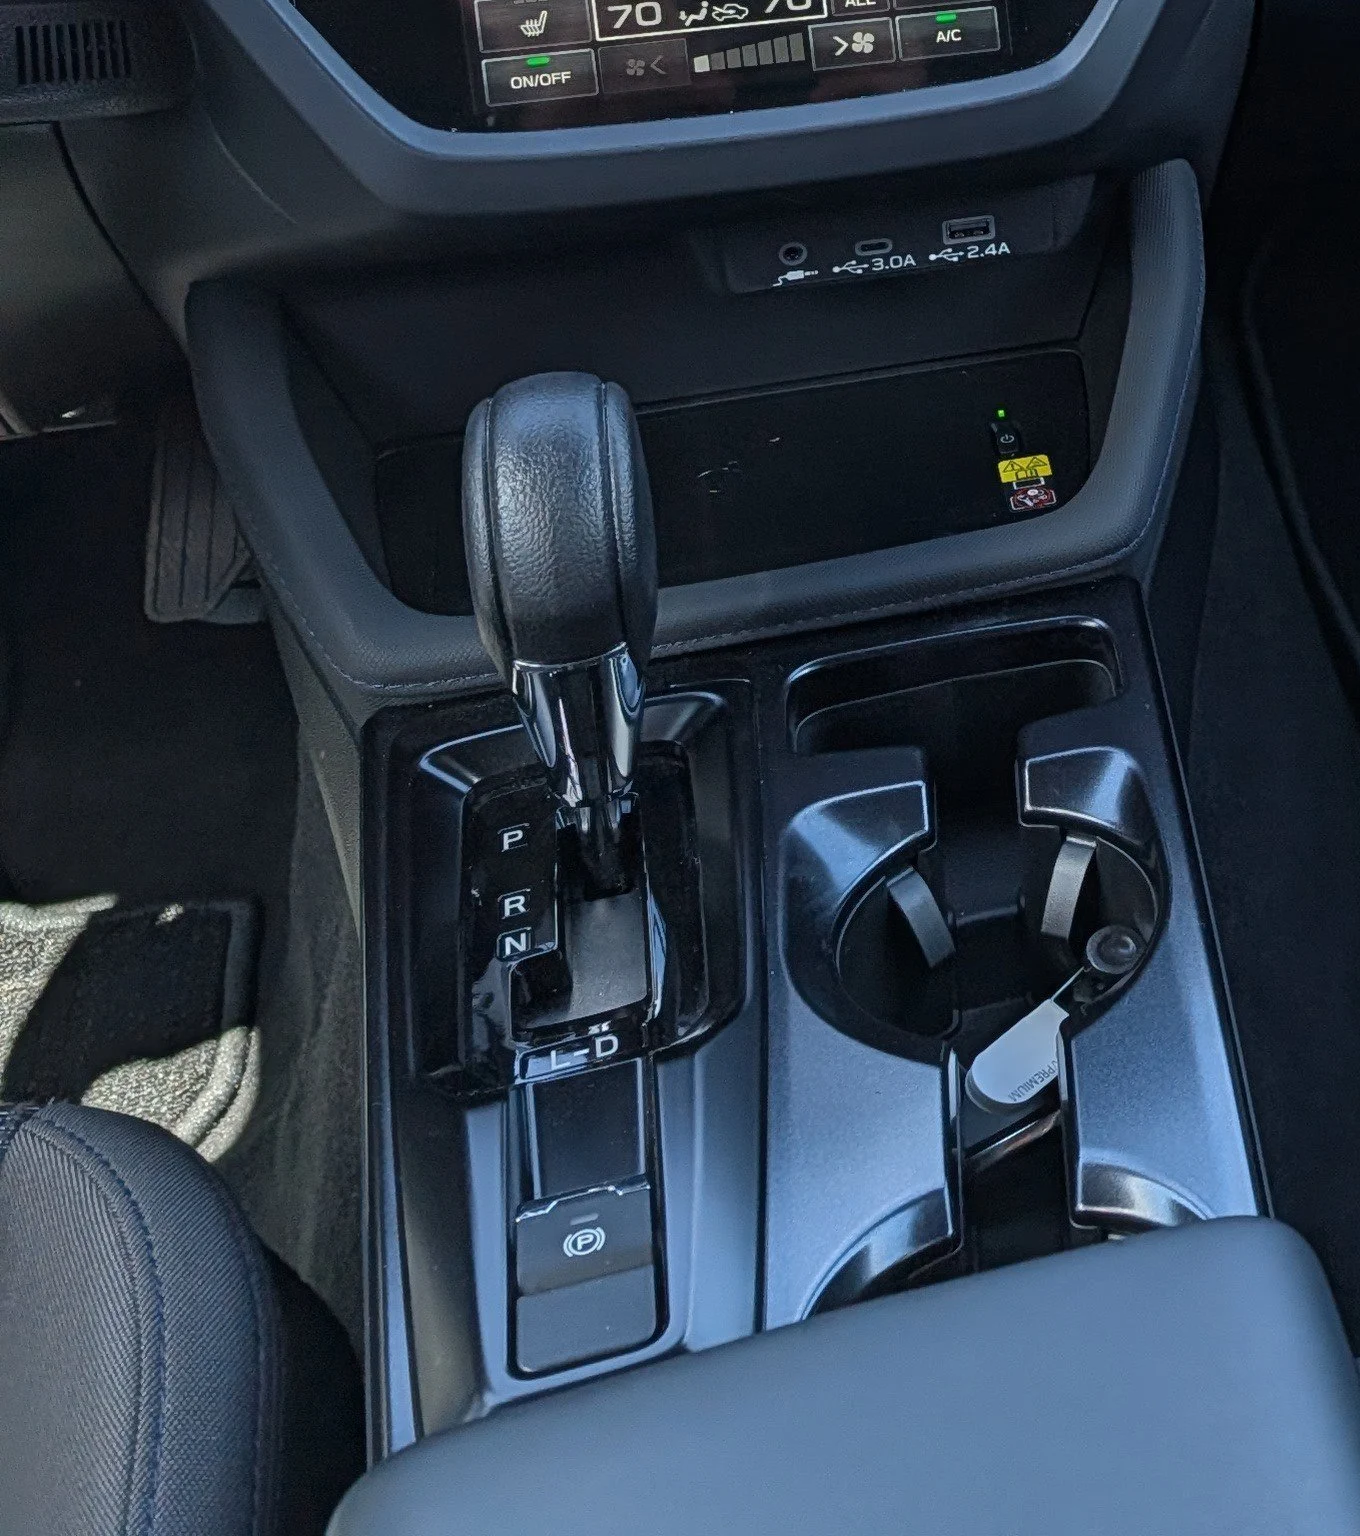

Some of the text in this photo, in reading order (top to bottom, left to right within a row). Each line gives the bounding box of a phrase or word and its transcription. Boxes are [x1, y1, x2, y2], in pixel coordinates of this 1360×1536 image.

[607, 1, 662, 29] 70
[936, 29, 962, 43] A/C
[510, 70, 572, 90] ON/OFF
[967, 242, 1011, 259] 2.4A
[872, 253, 917, 272] 3.0A
[503, 830, 524, 850] P
[504, 895, 527, 917] R
[504, 933, 527, 957] N
